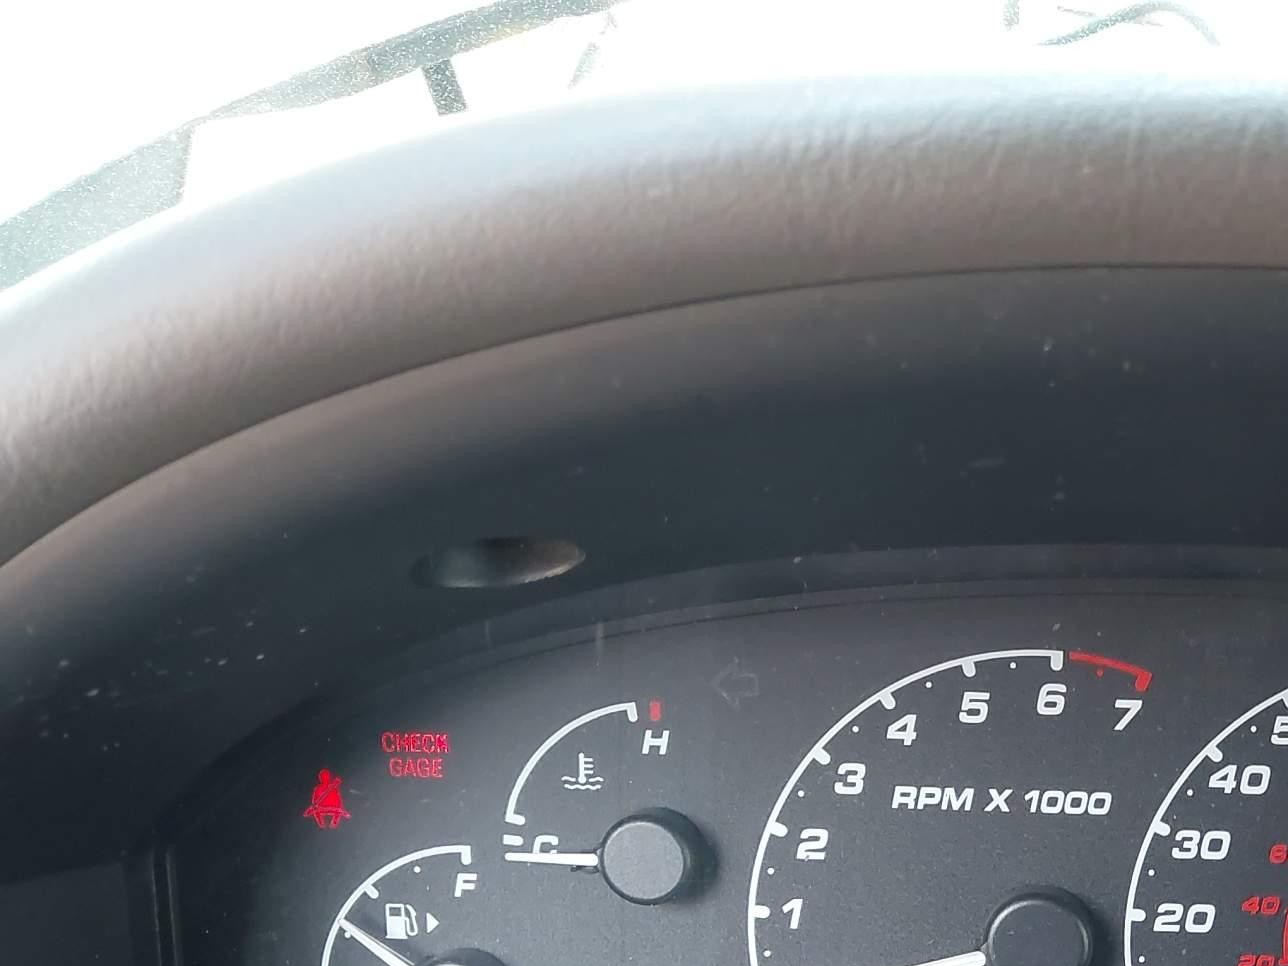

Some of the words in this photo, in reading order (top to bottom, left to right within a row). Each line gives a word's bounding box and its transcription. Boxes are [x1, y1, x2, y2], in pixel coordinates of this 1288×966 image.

[958, 692, 990, 723] 5
[1036, 683, 1067, 715] 6
[886, 714, 917, 745] 4
[1113, 699, 1143, 730] 7
[381, 732, 449, 754] CHECK
[642, 730, 670, 755] H
[388, 758, 444, 778] GAGE
[834, 763, 866, 795] 3
[1208, 764, 1271, 794] 40
[892, 785, 975, 811] RPM
[983, 789, 1013, 812] X
[1024, 790, 1112, 815] 1000
[532, 835, 559, 855] C
[796, 829, 829, 860] 2
[1170, 830, 1231, 860] 30
[454, 873, 478, 897] F
[782, 899, 804, 928] 1
[1153, 904, 1216, 933] 20
[1241, 896, 1280, 915] 40
